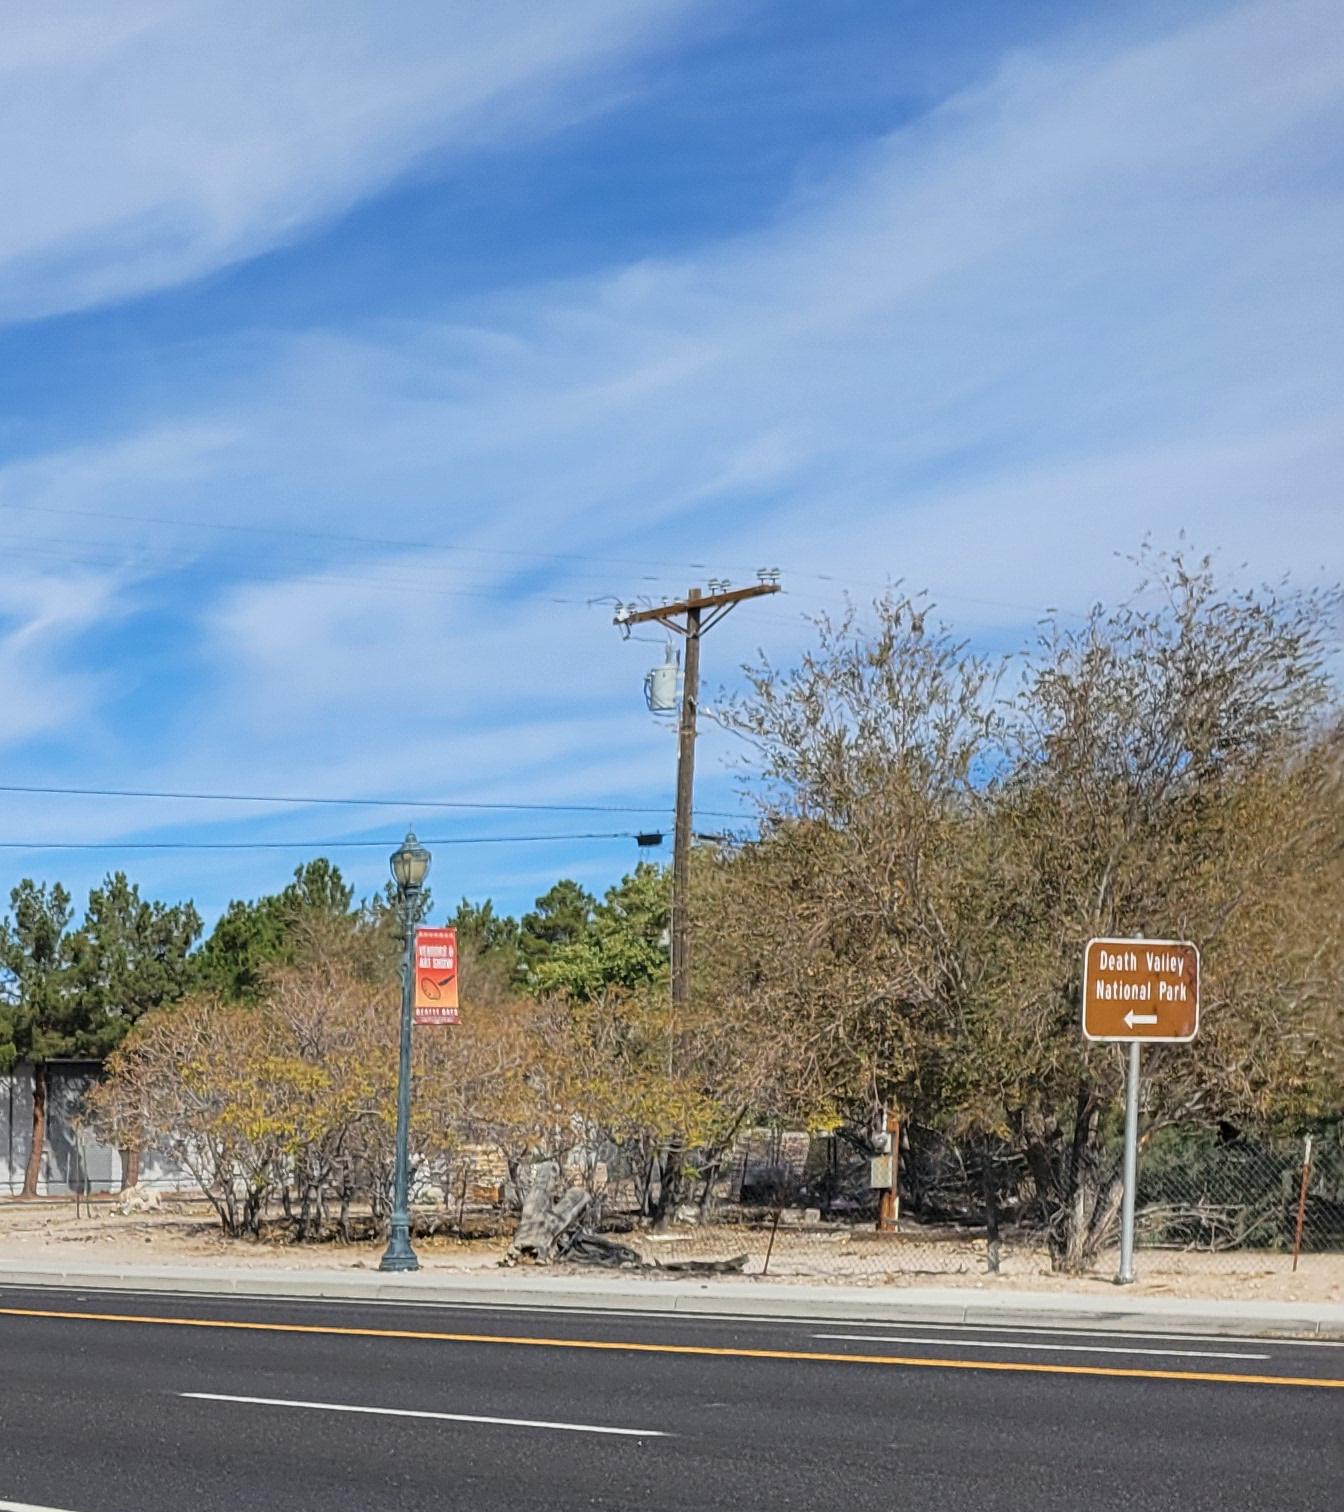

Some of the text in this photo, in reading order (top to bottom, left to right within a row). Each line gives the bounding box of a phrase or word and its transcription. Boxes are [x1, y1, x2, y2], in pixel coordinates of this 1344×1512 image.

[1099, 950, 1185, 977] Death Valley
[1096, 979, 1187, 1002] National Park
